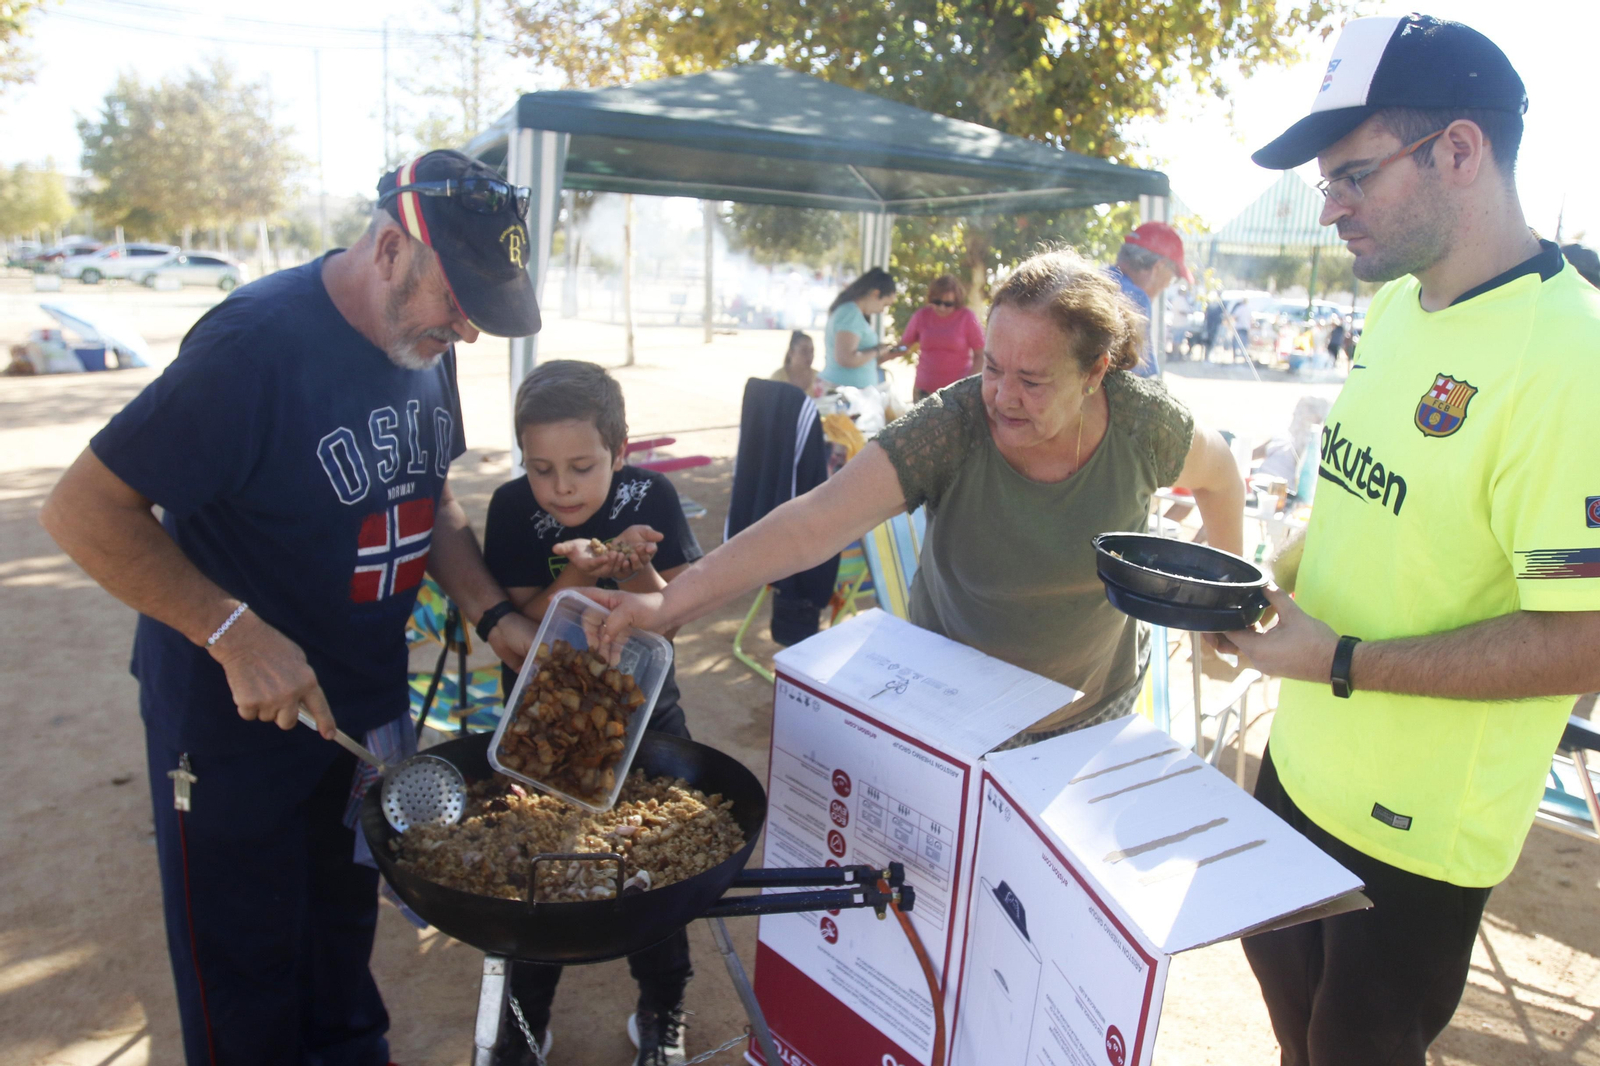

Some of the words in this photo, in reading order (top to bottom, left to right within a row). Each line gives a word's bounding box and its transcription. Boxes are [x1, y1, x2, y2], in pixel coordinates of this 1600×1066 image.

[1432, 399, 1450, 412] FCB
[317, 400, 453, 505] OSLO
[1320, 421, 1407, 516] akuten
[387, 482, 415, 500] NORWAY
[844, 719, 877, 739] ariston.com
[892, 742, 911, 754] GROUP
[912, 751, 934, 766] THERMO
[935, 762, 959, 778] ARISTON
[1041, 853, 1069, 887] ariston.com
[1088, 906, 1104, 927] GROUP
[1103, 923, 1122, 950] THERMO
[1122, 945, 1143, 973] ARISTON
